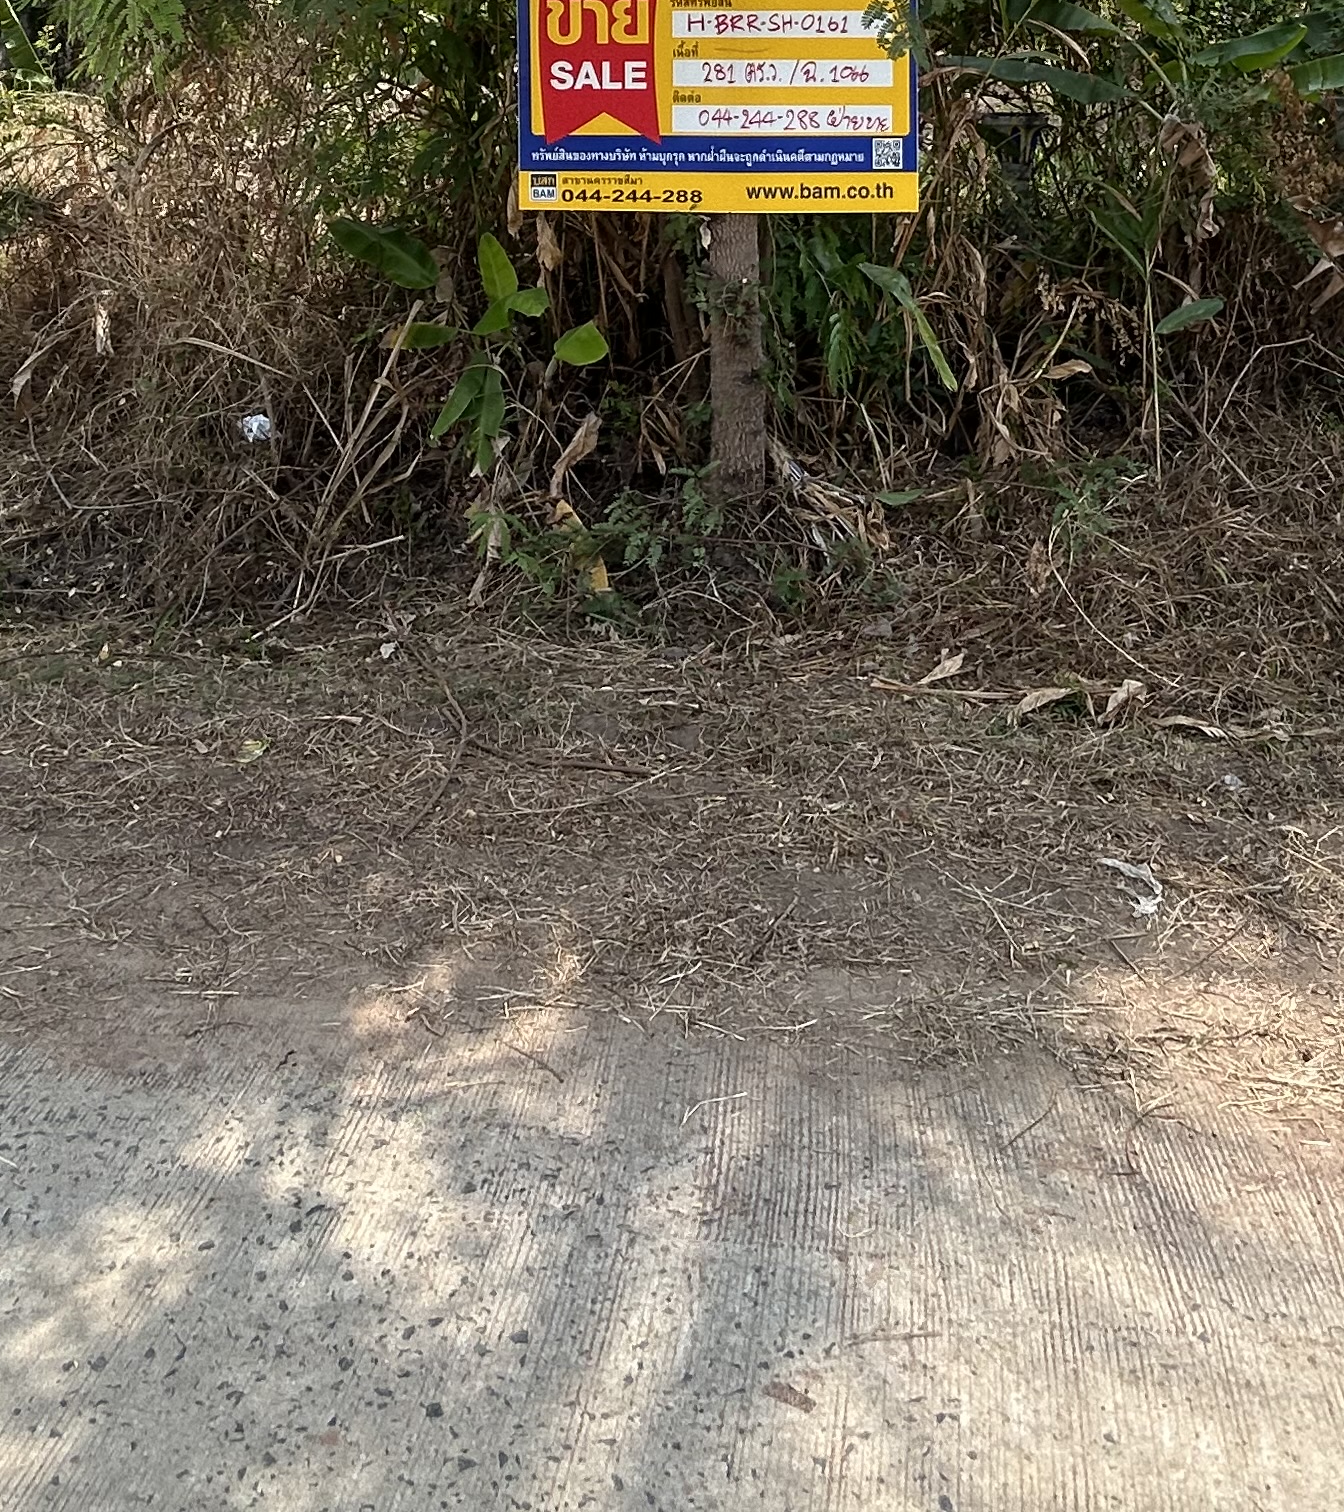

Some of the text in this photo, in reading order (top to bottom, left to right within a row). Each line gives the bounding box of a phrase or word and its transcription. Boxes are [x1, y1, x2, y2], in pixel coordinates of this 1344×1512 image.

[673, 41, 699, 57] เนื้อที่
[550, 61, 648, 90] SALE
[702, 62, 736, 84] 281
[672, 91, 702, 103] ติดต่อ
[699, 108, 820, 131] 044-244-288
[531, 147, 636, 162] ทรัพย์สินของทางบริษัท
[638, 148, 686, 166] ห้ามบุกรุก
[532, 189, 555, 199] BAM
[561, 189, 703, 203] 044-244-288
[746, 182, 894, 200] www.bam.co.th
